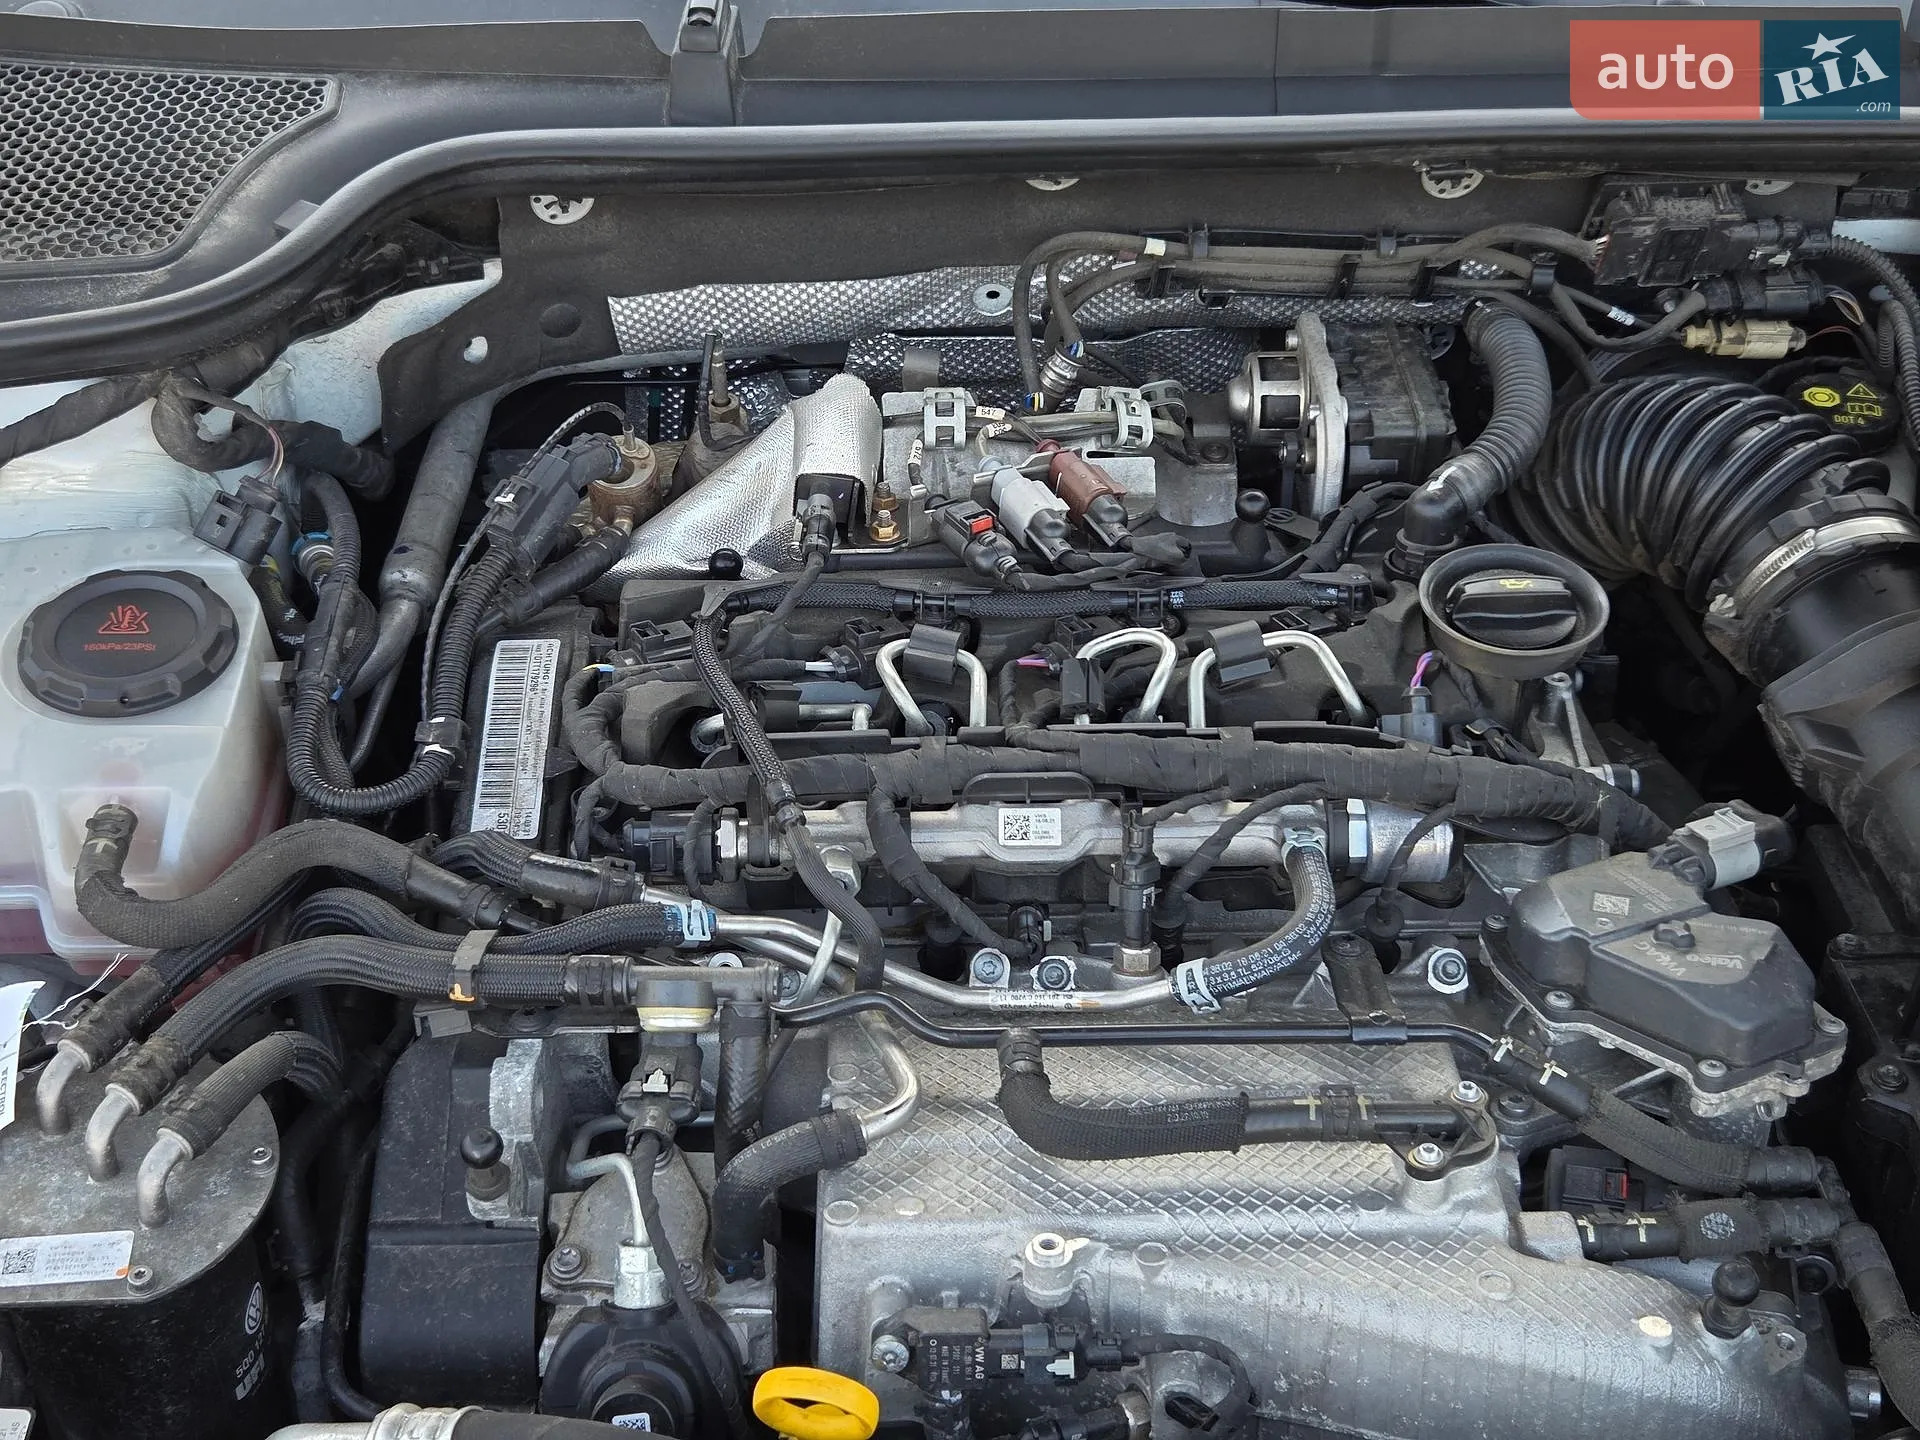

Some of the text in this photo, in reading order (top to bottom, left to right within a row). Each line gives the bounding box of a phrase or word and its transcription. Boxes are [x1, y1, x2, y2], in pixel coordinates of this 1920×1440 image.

[1833, 414, 1865, 425] DOT 4
[1686, 953, 1744, 970] Valeo
[975, 1347, 985, 1380] VW AG
